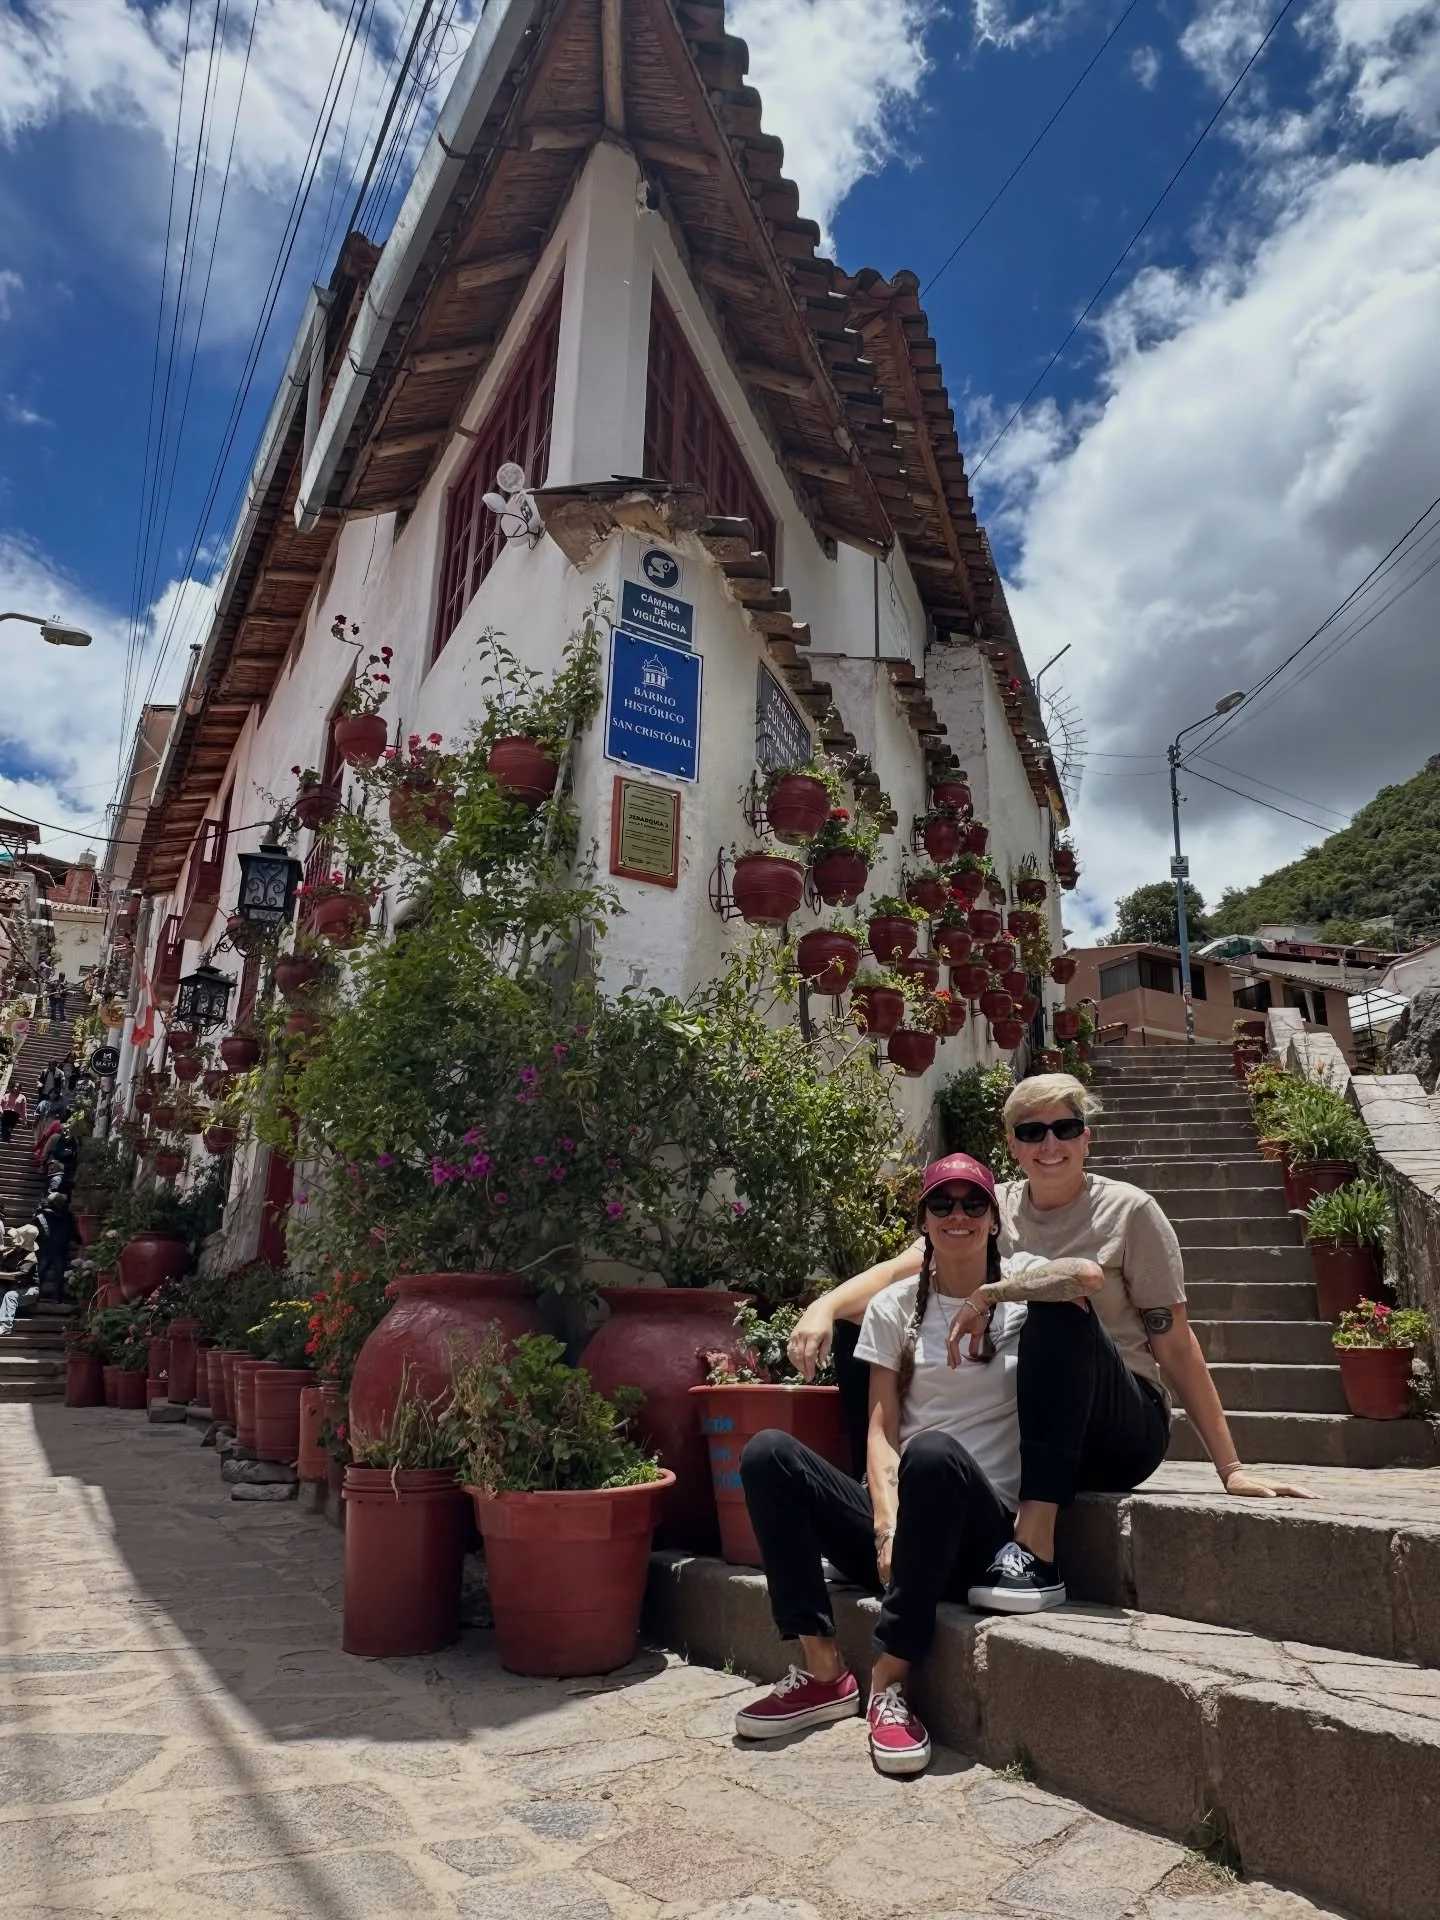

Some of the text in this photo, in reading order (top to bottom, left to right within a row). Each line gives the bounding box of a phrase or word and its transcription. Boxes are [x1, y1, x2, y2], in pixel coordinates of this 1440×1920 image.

[640, 593, 681, 614] CÁMARA
[654, 607, 667, 619] DE
[632, 608, 687, 635] VIGILANCIA
[634, 686, 676, 707] BARRIO
[624, 698, 685, 724] HISTÓRICO
[772, 689, 799, 737] PARQUE
[612, 717, 694, 748] SAN CRISTÓBAL
